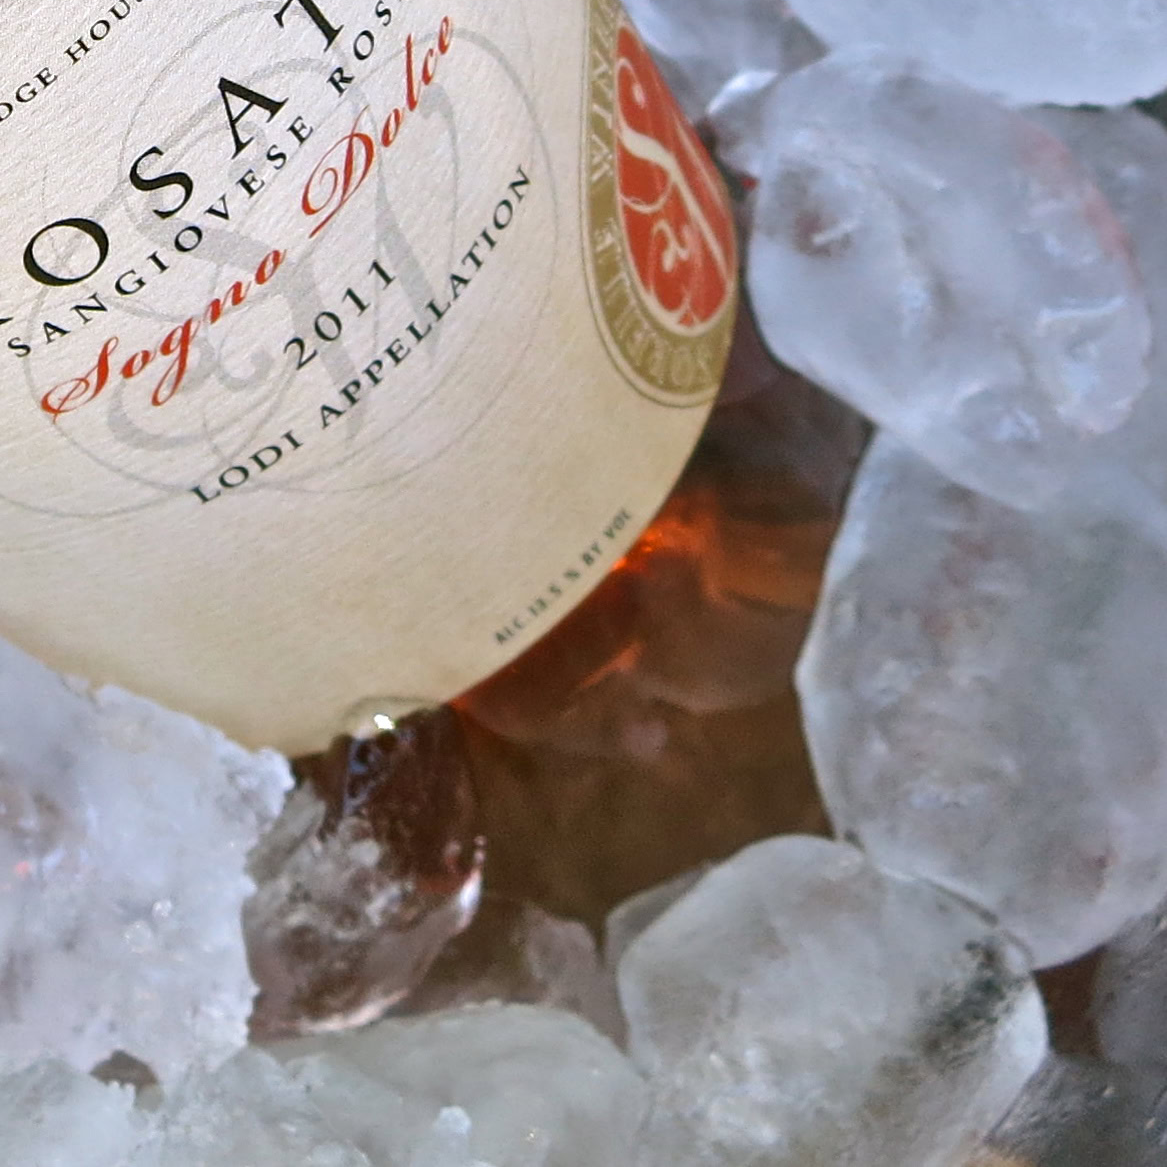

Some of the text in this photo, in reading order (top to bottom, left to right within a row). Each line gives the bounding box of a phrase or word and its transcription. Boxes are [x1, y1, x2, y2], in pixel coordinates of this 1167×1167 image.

[7, 117, 313, 358] SANGIOVESE
[40, 248, 287, 423] Sogno
[301, 15, 454, 239] Dolce
[191, 431, 303, 503] LODI
[320, 163, 532, 429] APPELLATION
[283, 259, 396, 371] 2011
